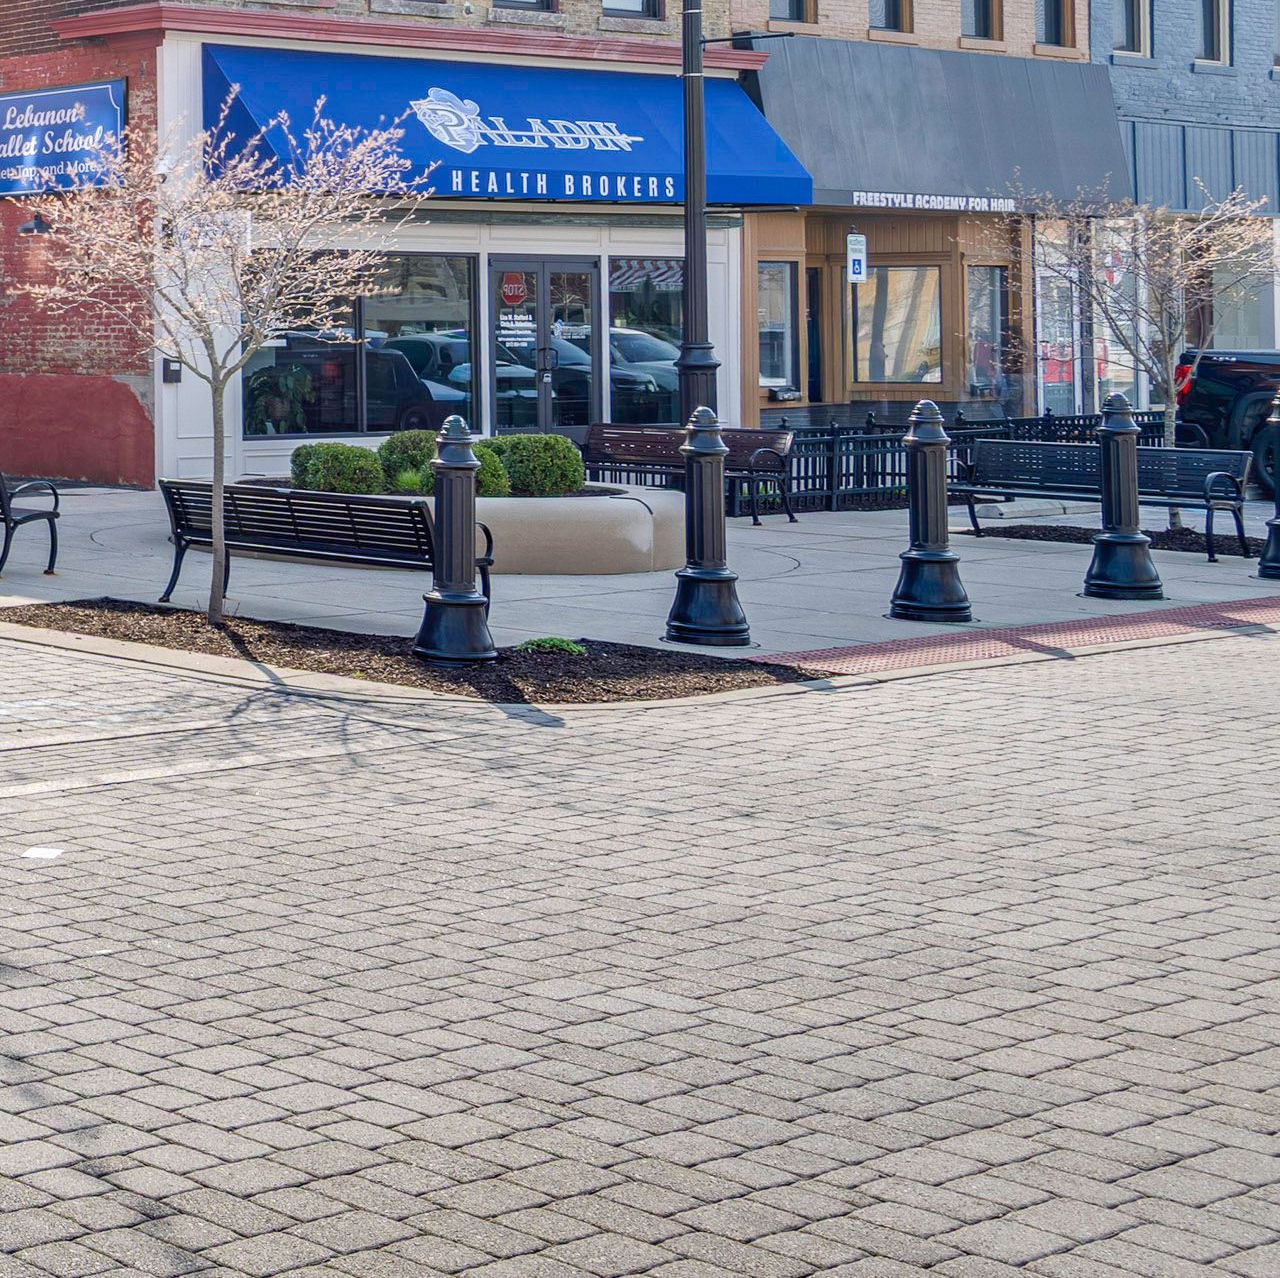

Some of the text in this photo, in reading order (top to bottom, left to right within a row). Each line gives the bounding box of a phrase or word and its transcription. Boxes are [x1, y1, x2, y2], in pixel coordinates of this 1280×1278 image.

[2, 104, 79, 130] Lebanon
[438, 109, 632, 152] PALADIN
[42, 126, 103, 155] School
[44, 162, 64, 176] and
[451, 169, 675, 198] HEALTH BROKERS
[852, 191, 1016, 212] FREESTYLE ACADEMY FOR HAIR
